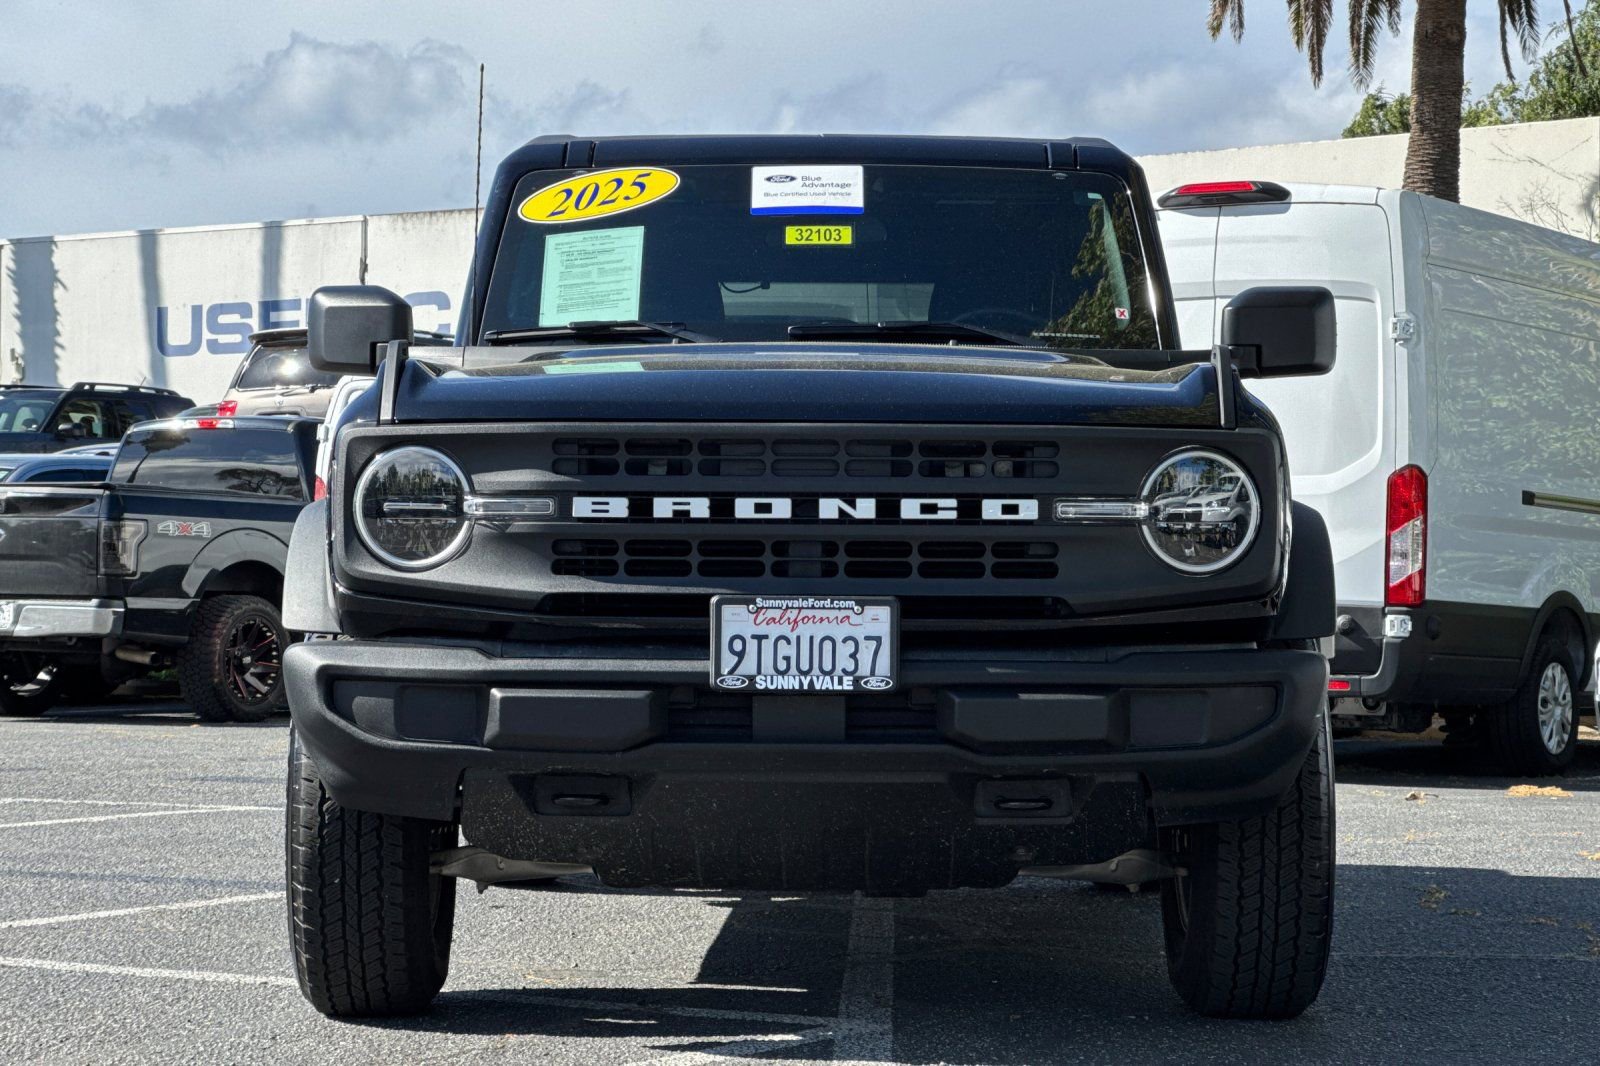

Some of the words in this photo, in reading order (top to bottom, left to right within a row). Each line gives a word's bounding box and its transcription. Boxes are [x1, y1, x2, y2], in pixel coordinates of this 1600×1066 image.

[546, 172, 652, 218] 2025
[795, 228, 842, 242] 32103
[572, 497, 1039, 520] BRONCO
[755, 598, 856, 609] SunnyvaleFord.com
[753, 608, 863, 632] California
[727, 634, 883, 676] 9TGU037
[755, 675, 854, 690] SUNNYVALE
